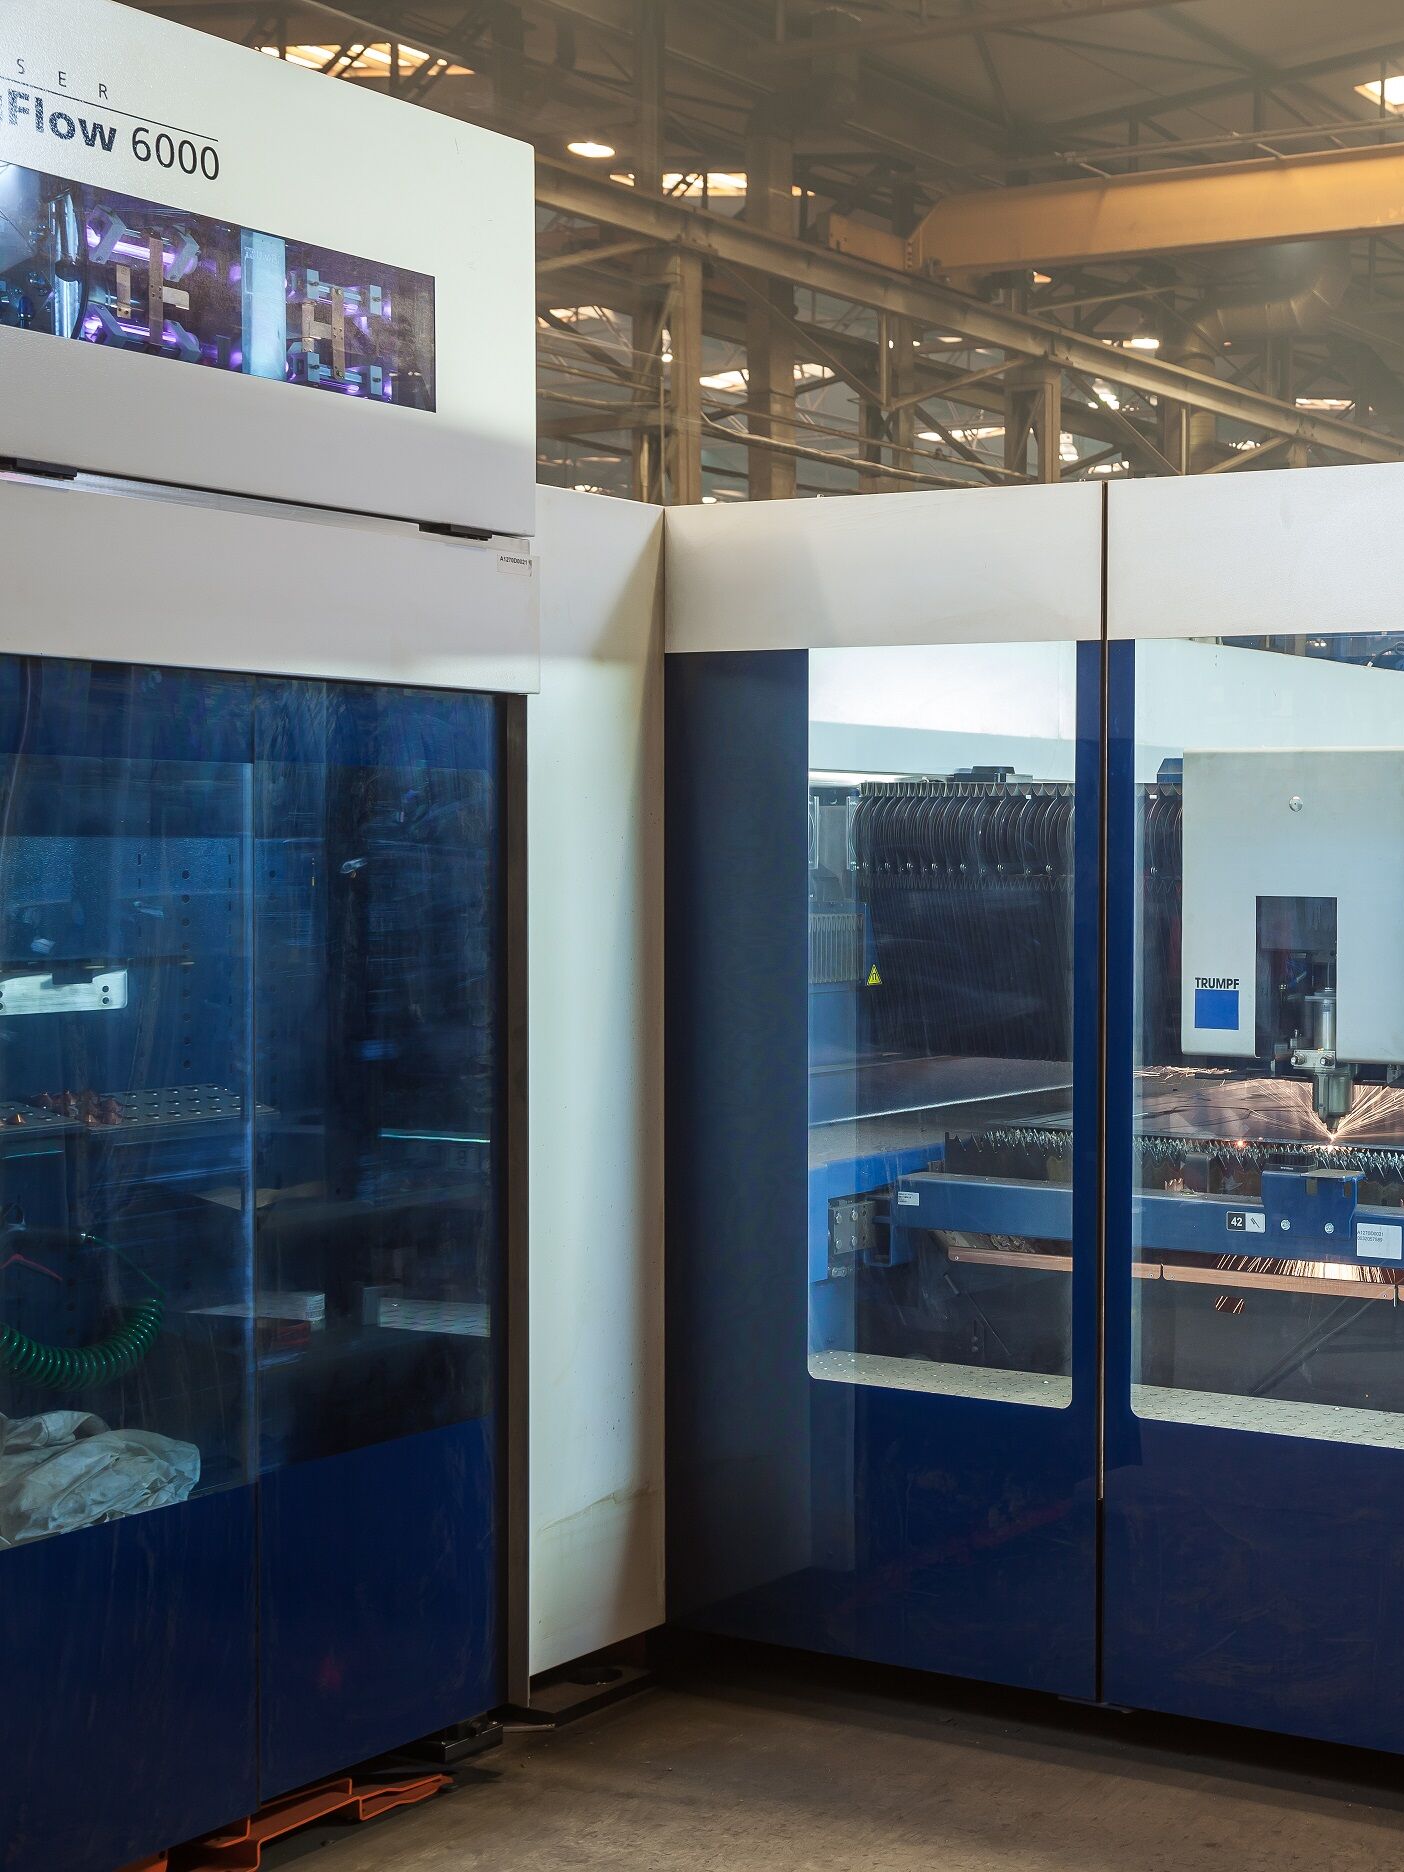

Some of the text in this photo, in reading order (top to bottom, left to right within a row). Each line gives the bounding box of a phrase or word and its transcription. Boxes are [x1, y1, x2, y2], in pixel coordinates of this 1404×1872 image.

[132, 126, 219, 181] 6000
[1195, 977, 1239, 989] TRUMPF
[1230, 1217, 1243, 1227] 42
